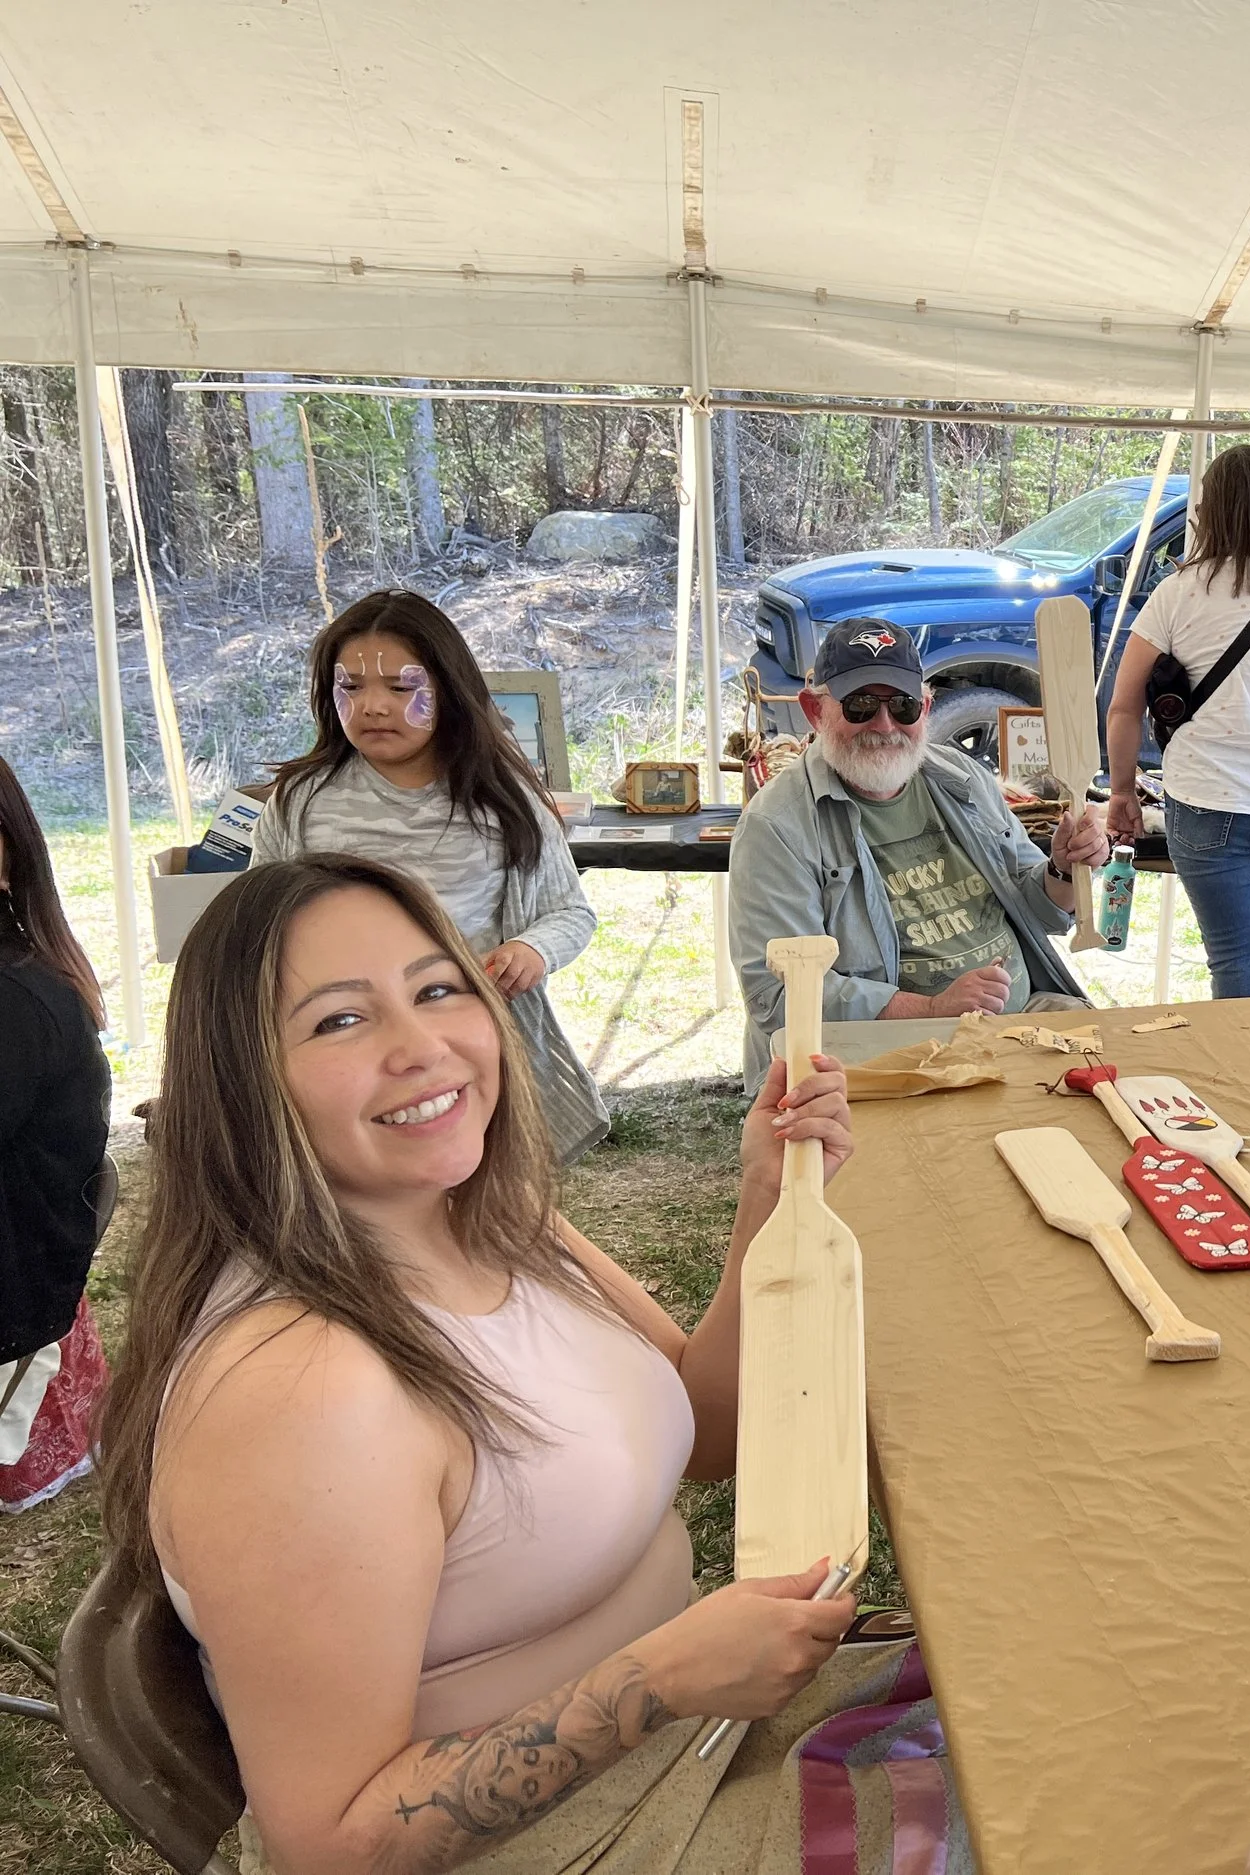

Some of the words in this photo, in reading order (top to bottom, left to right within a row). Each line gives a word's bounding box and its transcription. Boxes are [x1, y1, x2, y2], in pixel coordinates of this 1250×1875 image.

[1011, 718, 1041, 729] Gifts
[1036, 735, 1047, 744] th
[218, 813, 254, 833] ProSa
[882, 858, 945, 896] UCKY
[891, 873, 986, 921] ISHING
[906, 909, 974, 947] SHIRT
[899, 962, 917, 974] O
[927, 957, 966, 972] NOT
